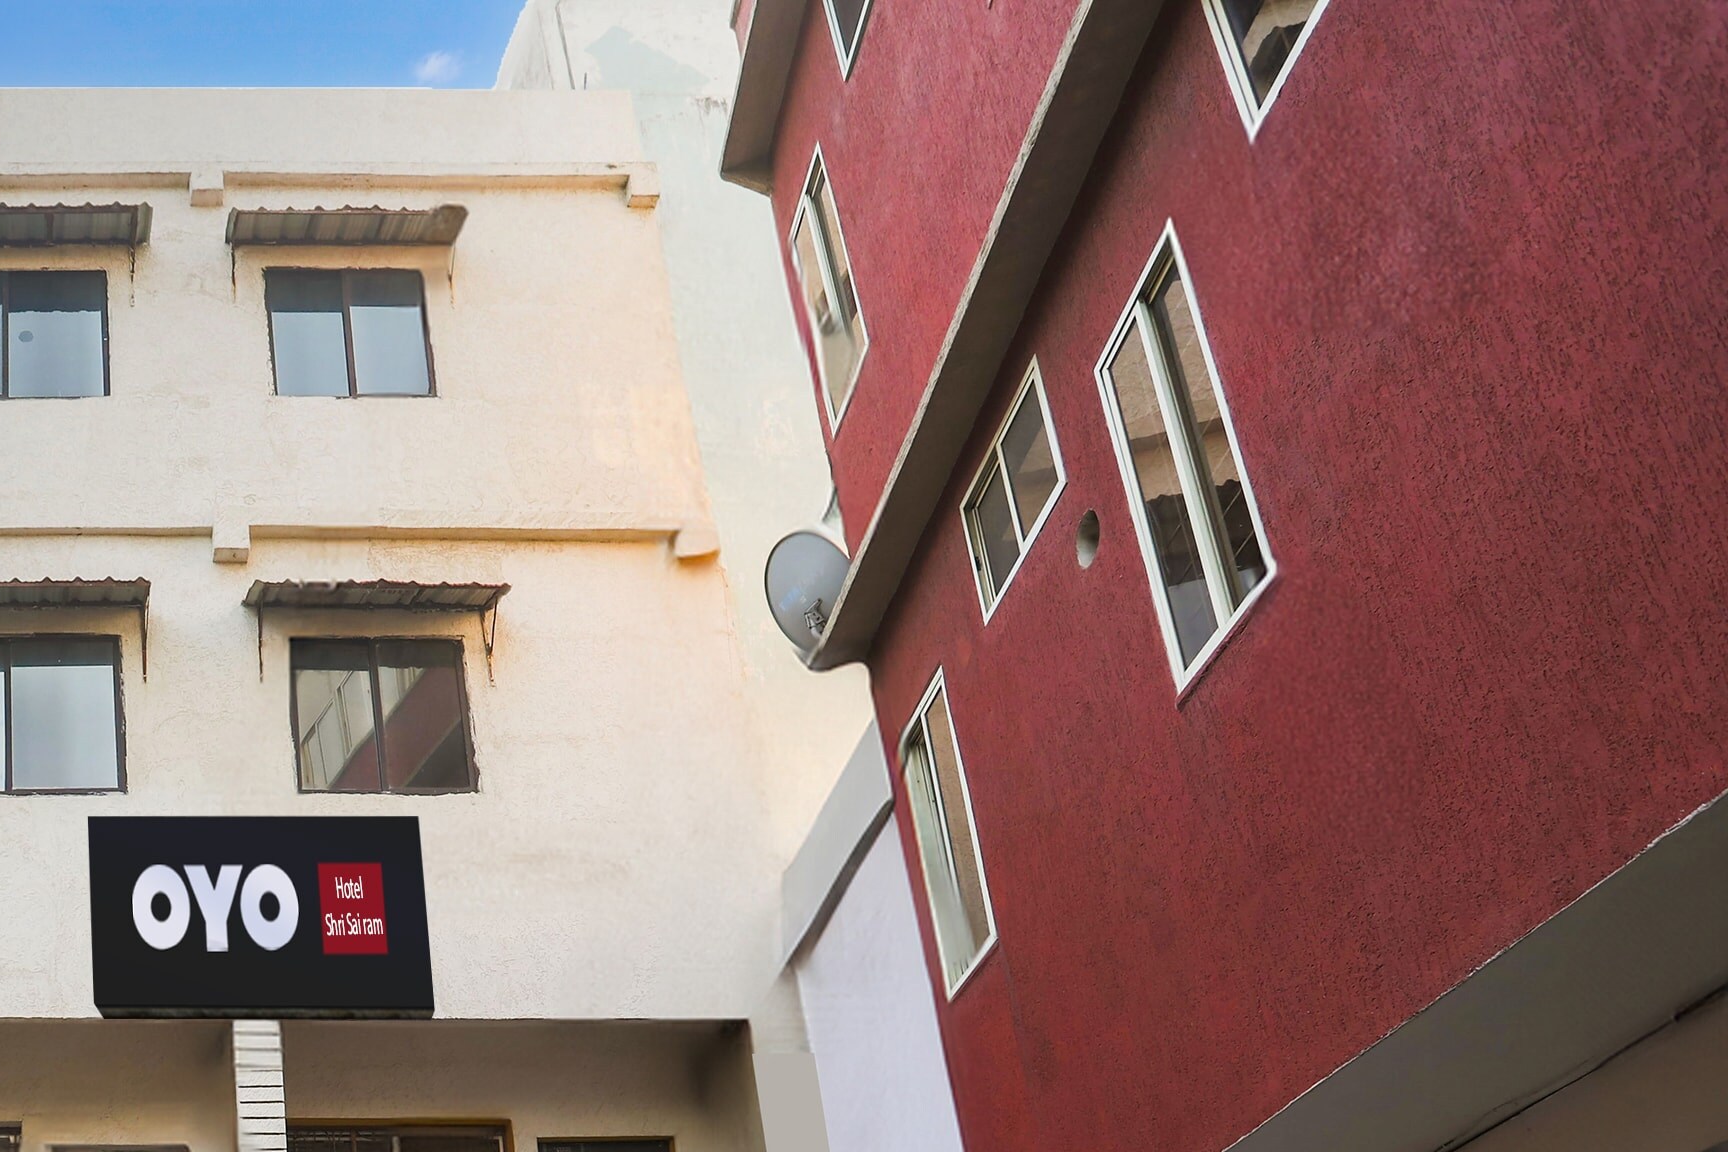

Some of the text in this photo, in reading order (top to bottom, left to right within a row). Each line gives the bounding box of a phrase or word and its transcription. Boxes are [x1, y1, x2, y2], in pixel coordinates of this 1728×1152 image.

[334, 875, 364, 900] Hotel
[132, 864, 299, 952] OYO
[325, 912, 346, 936] Shri
